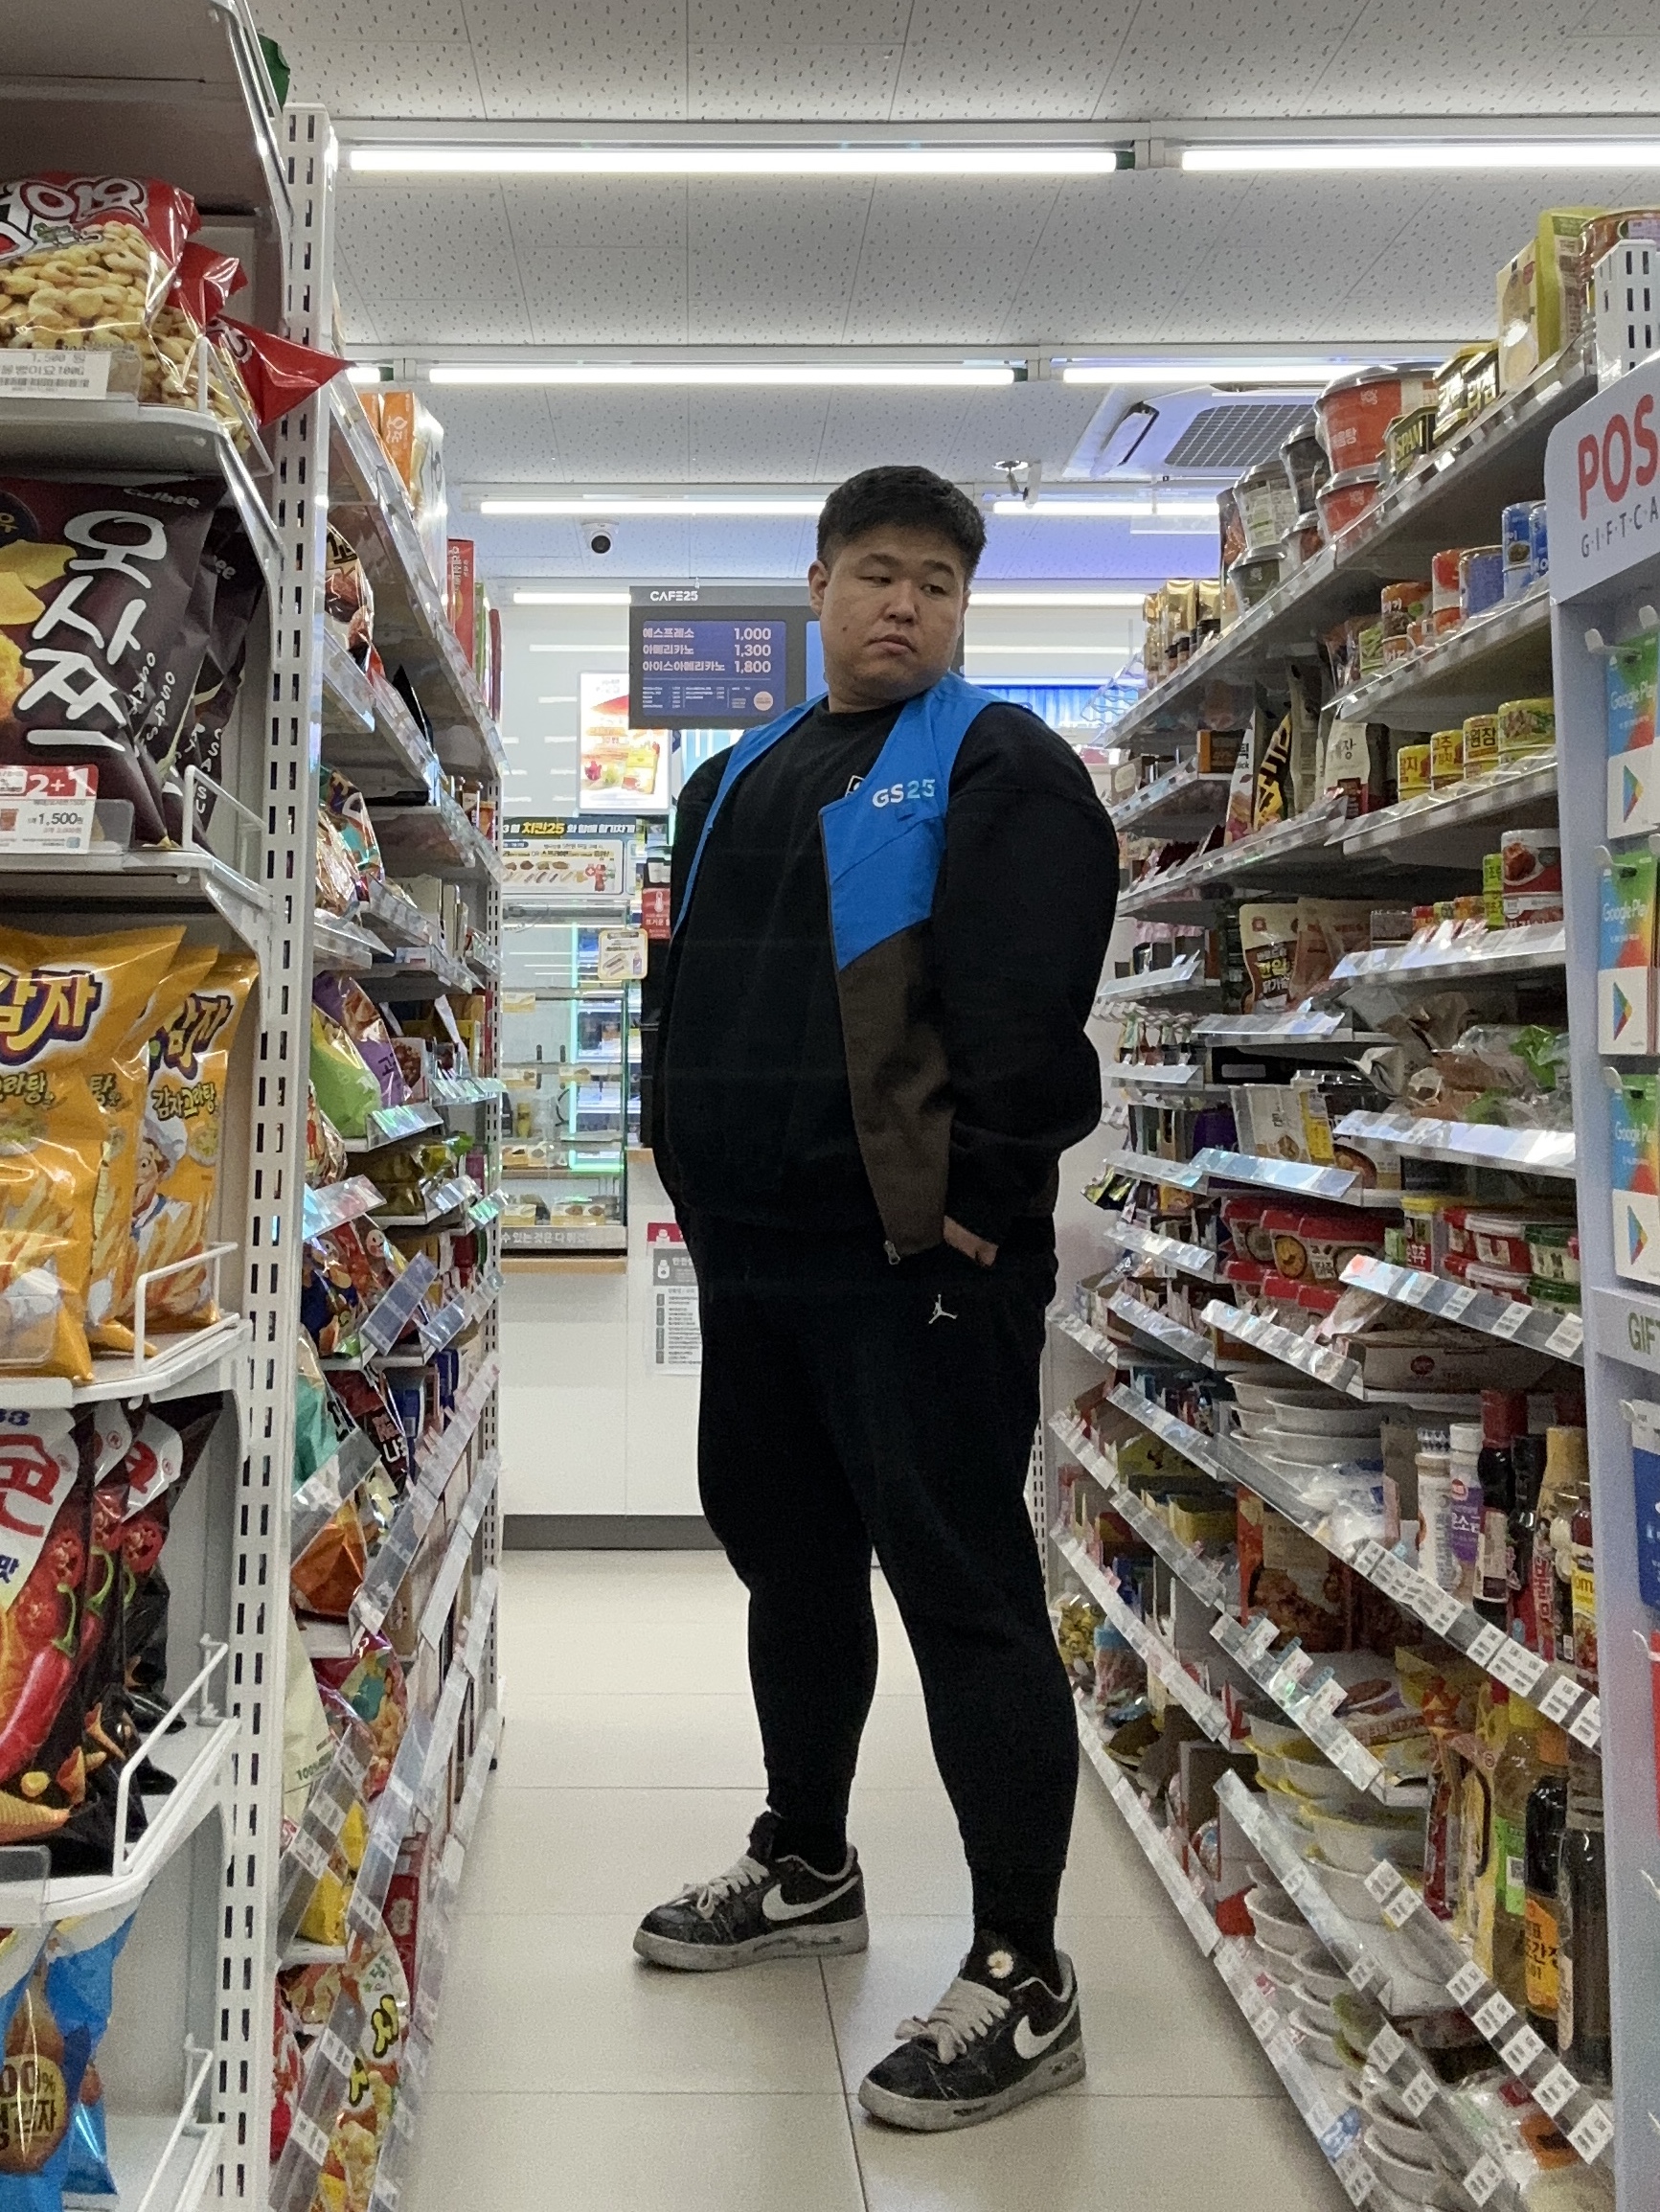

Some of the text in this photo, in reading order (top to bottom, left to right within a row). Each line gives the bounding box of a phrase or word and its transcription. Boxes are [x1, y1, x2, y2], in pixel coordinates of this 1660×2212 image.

[649, 590, 699, 602] CAFE25
[643, 627, 772, 641] 에스프레소 1,000
[643, 645, 772, 657] 아메리카노 1,300
[643, 661, 772, 673] 아이스아메리카노 1,800
[26, 767, 89, 799] 2+1
[872, 779, 936, 808] GS25
[1627, 1311, 1660, 1355] GIF
